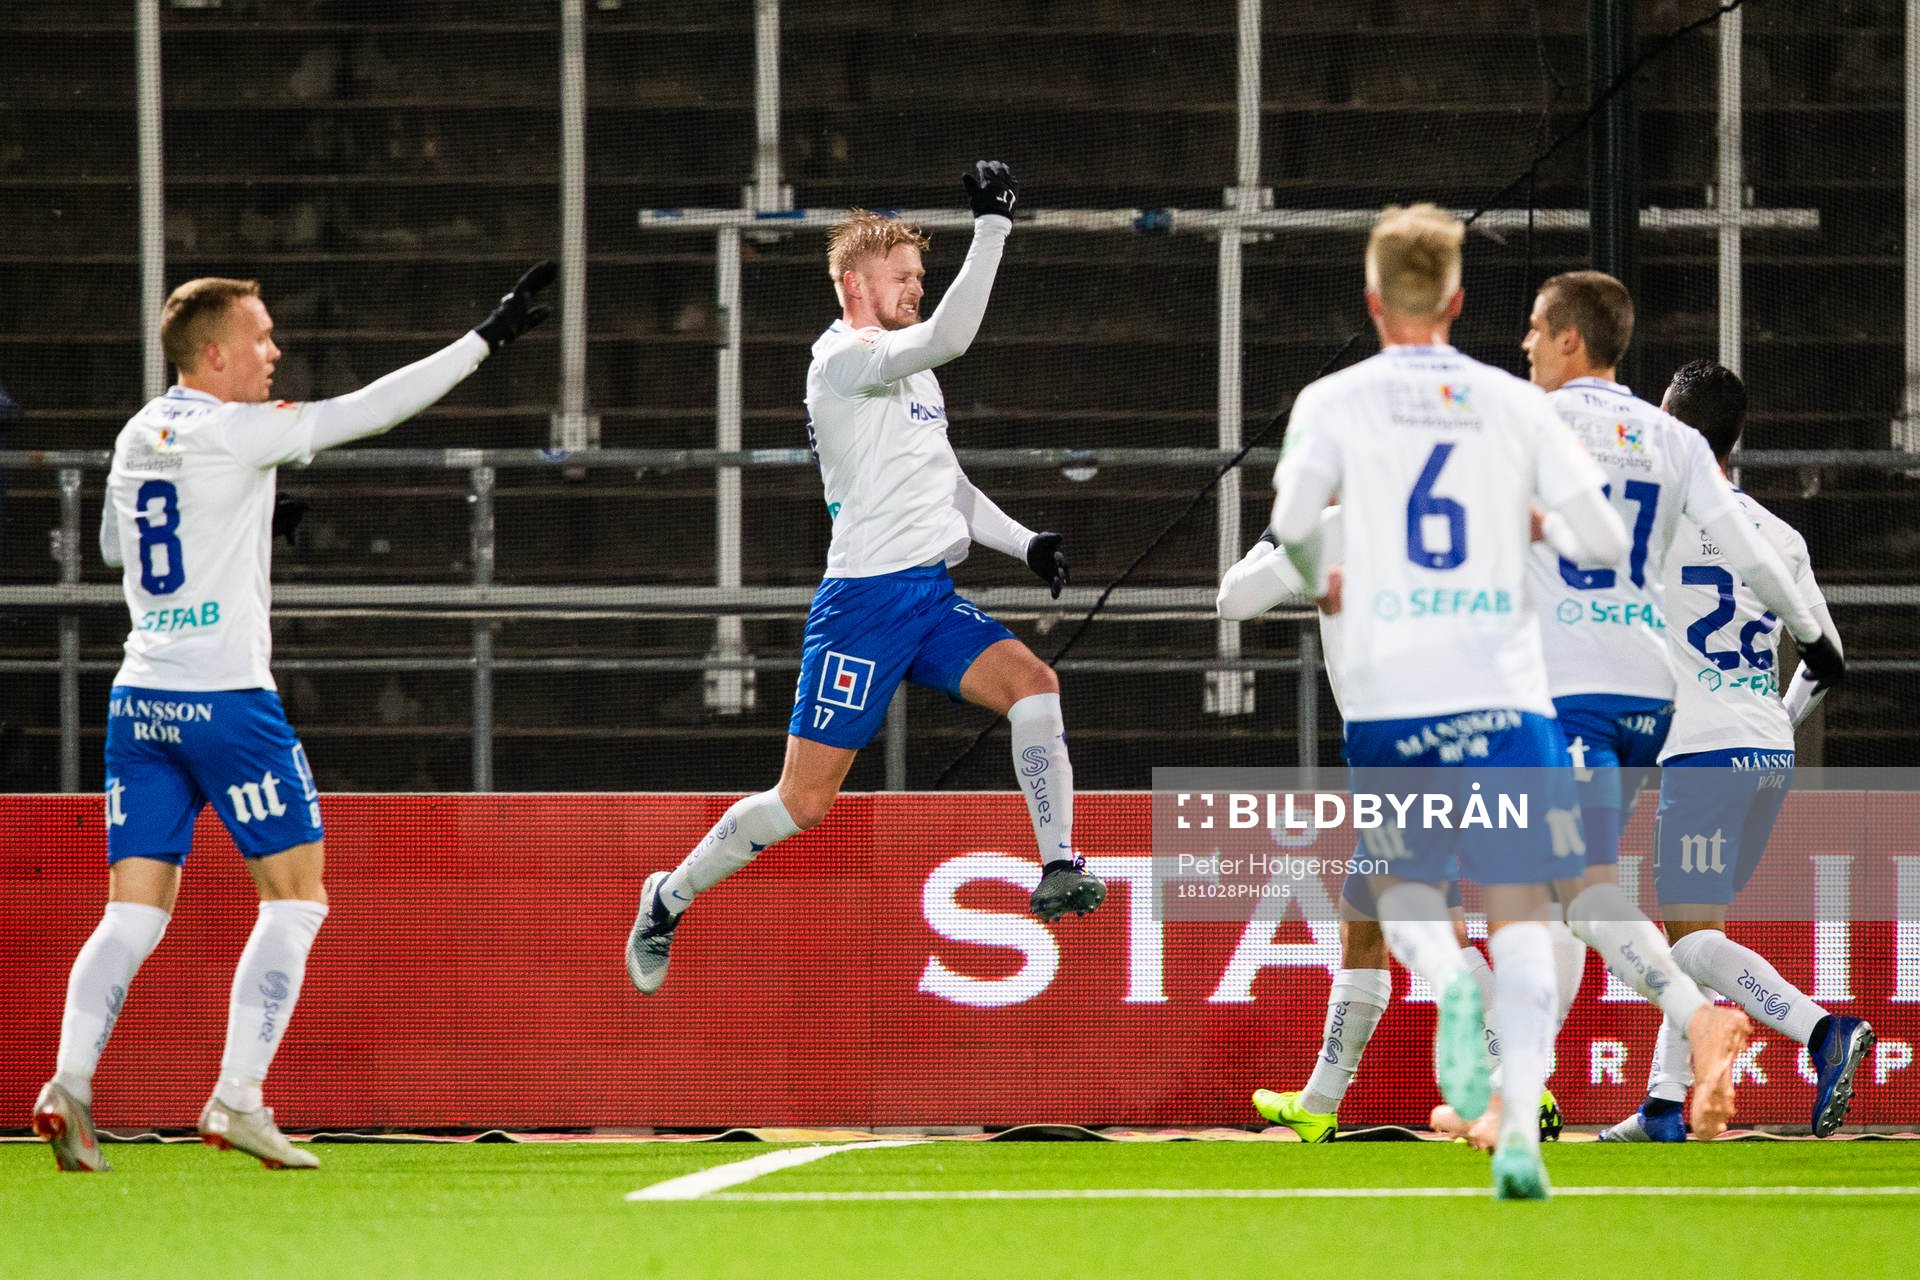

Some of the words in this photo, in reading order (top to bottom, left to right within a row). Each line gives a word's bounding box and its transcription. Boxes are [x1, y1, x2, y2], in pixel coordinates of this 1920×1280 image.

[1406, 442, 1468, 570] 6
[135, 479, 186, 596] 8
[137, 601, 221, 633] SEFAB
[1410, 588, 1511, 618] SEFAB
[110, 695, 213, 723] MÅNSSON
[813, 704, 835, 730] 17
[133, 719, 183, 744] RÖR
[226, 770, 287, 824] nt
[1680, 828, 1727, 874] nt
